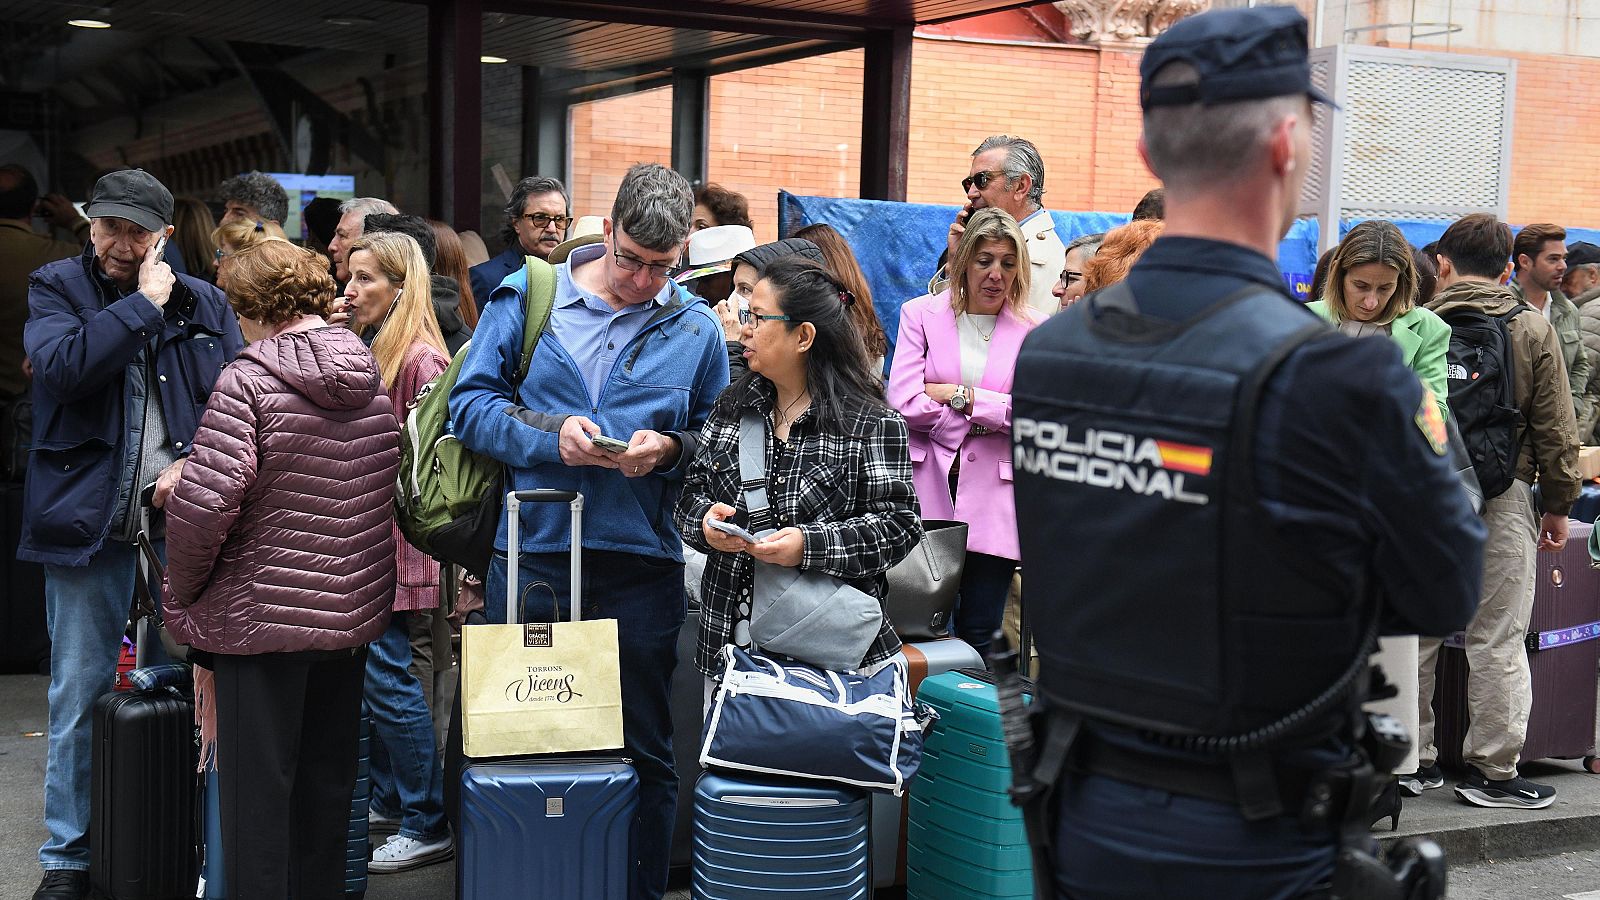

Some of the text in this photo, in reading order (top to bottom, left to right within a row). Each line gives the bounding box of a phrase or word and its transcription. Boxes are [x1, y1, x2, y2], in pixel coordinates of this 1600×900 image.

[1013, 417, 1164, 467] POLICIA
[1013, 445, 1209, 505] NACIONAL
[505, 674, 583, 703] Vicens
